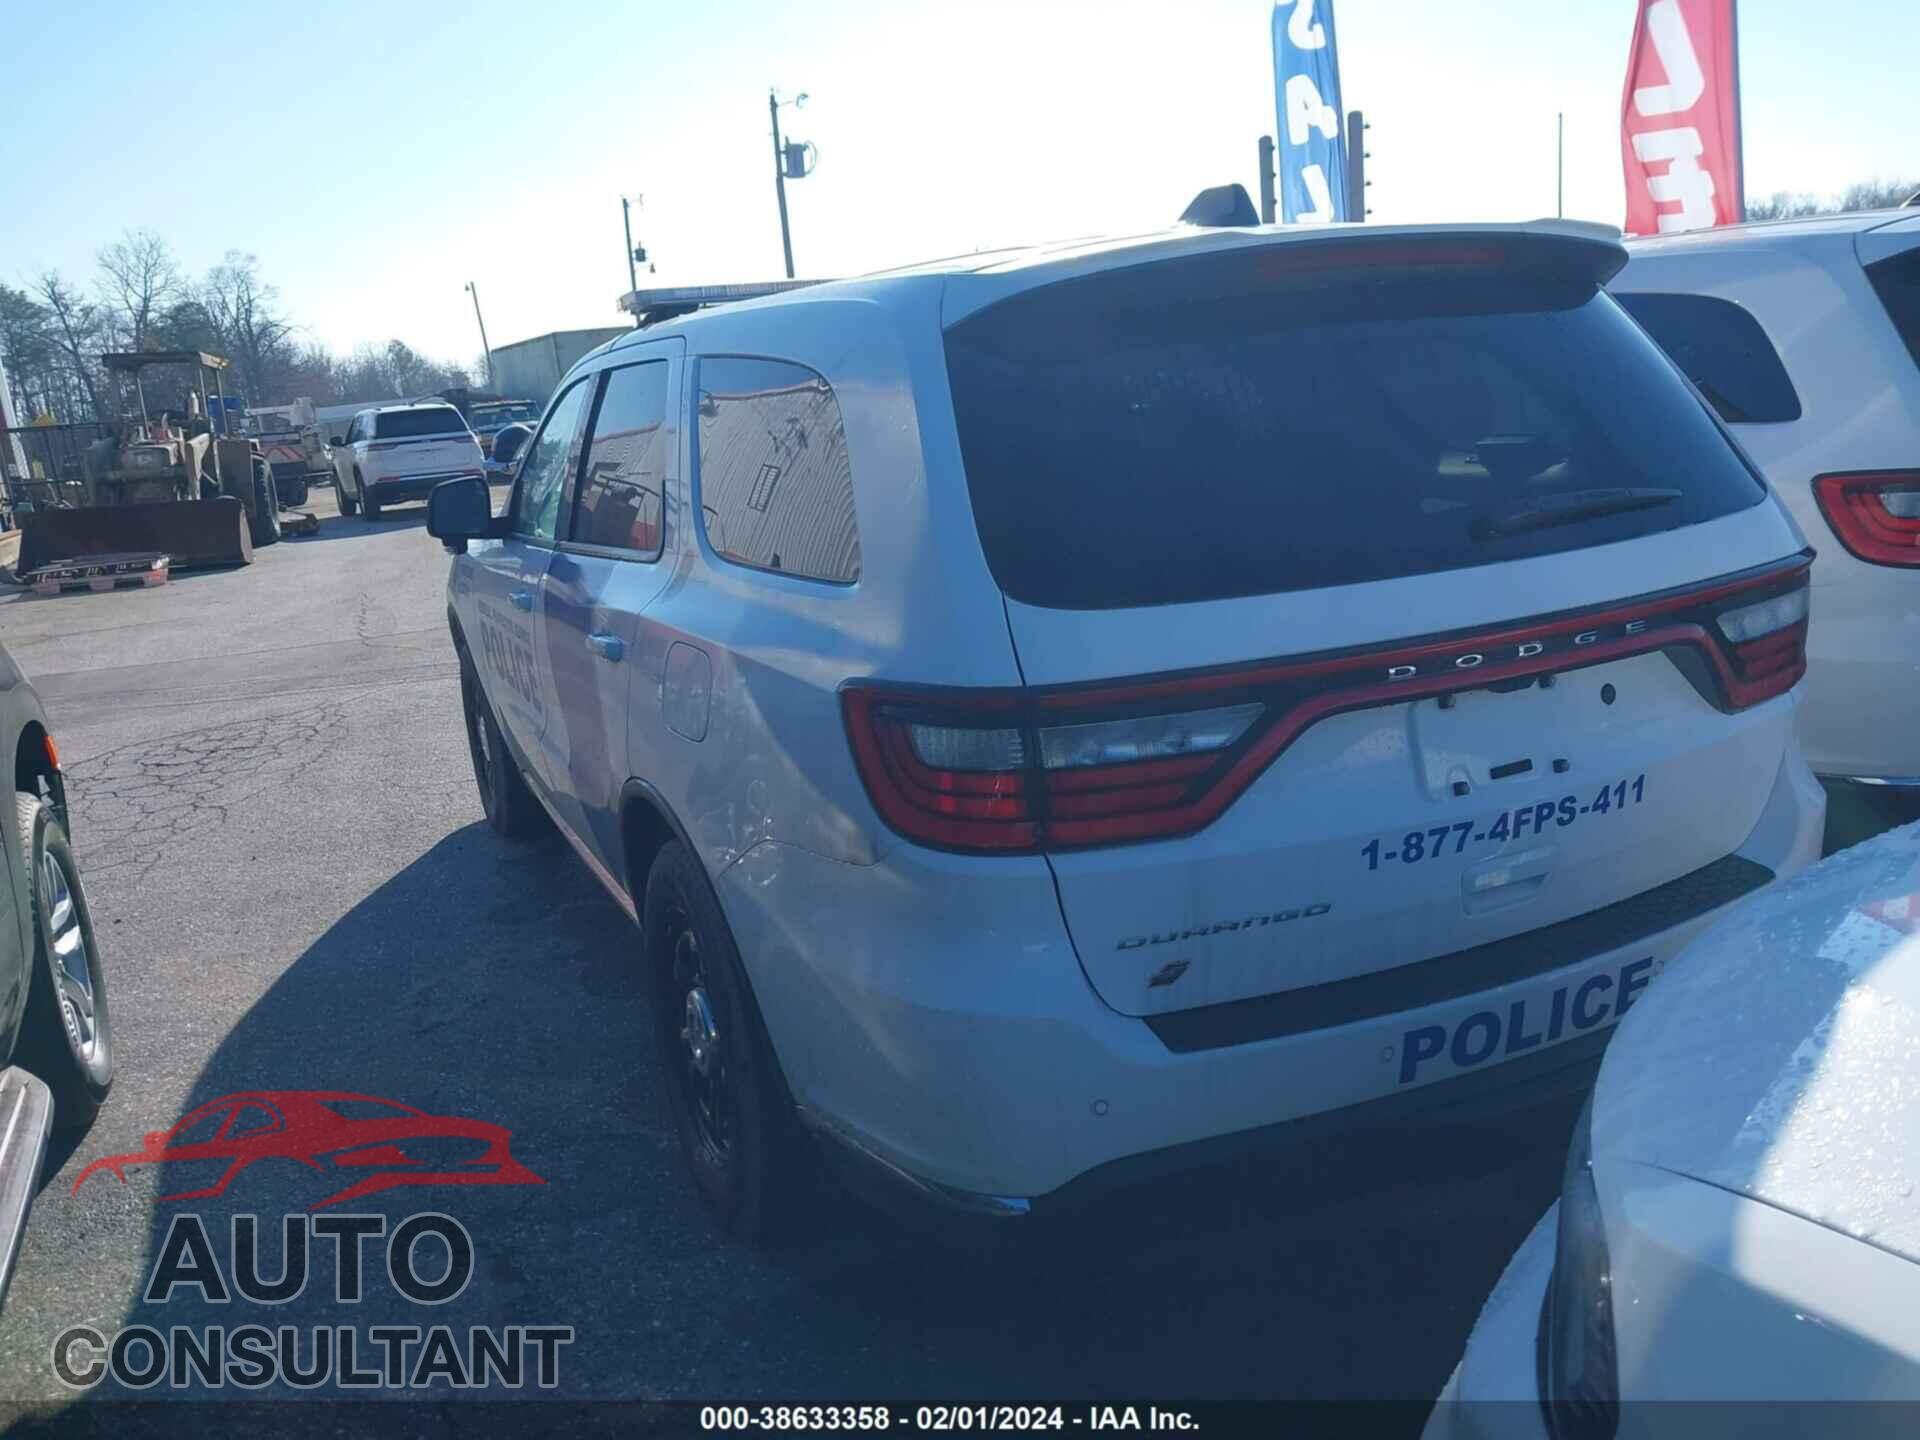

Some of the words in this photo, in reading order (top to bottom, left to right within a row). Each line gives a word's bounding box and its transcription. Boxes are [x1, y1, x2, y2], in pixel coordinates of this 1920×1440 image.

[1388, 620, 1647, 678] DODGE
[1361, 774, 1645, 870] 1-877-4FPS-411
[1116, 903, 1332, 950] DURANGO
[1399, 956, 1653, 1084] POLICE
